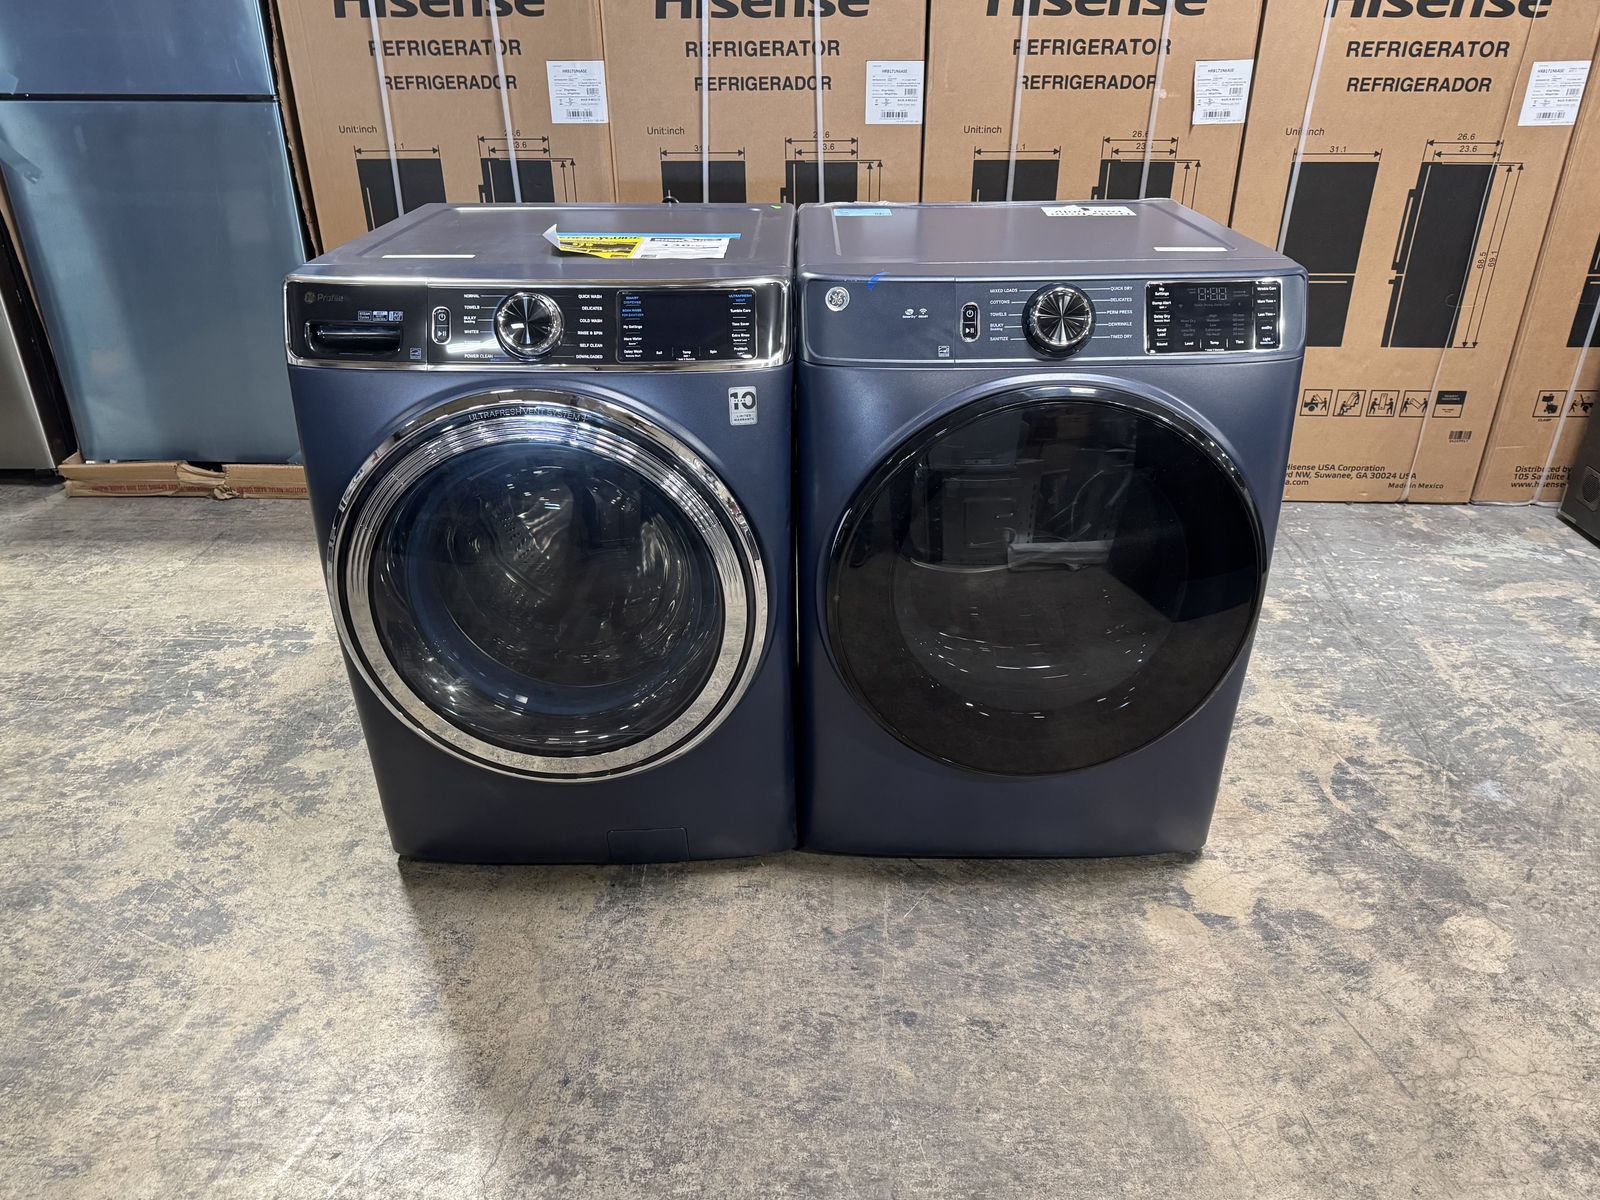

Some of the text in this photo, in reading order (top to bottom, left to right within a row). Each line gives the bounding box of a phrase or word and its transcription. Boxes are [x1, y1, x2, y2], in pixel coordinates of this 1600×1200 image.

[1346, 41, 1510, 58] REFRIGERATOR
[1346, 77, 1492, 92] REFRIGERADOR
[338, 125, 377, 133] Unit:inch
[963, 126, 1002, 134] Unit:inch
[1477, 252, 1487, 269] 68.5
[1488, 251, 1497, 267] 69.1
[730, 392, 756, 410] 10
[468, 408, 521, 421] ULTRAFRESH
[1338, 464, 1385, 472] Corporation
[1314, 472, 1353, 480] Suwanee,
